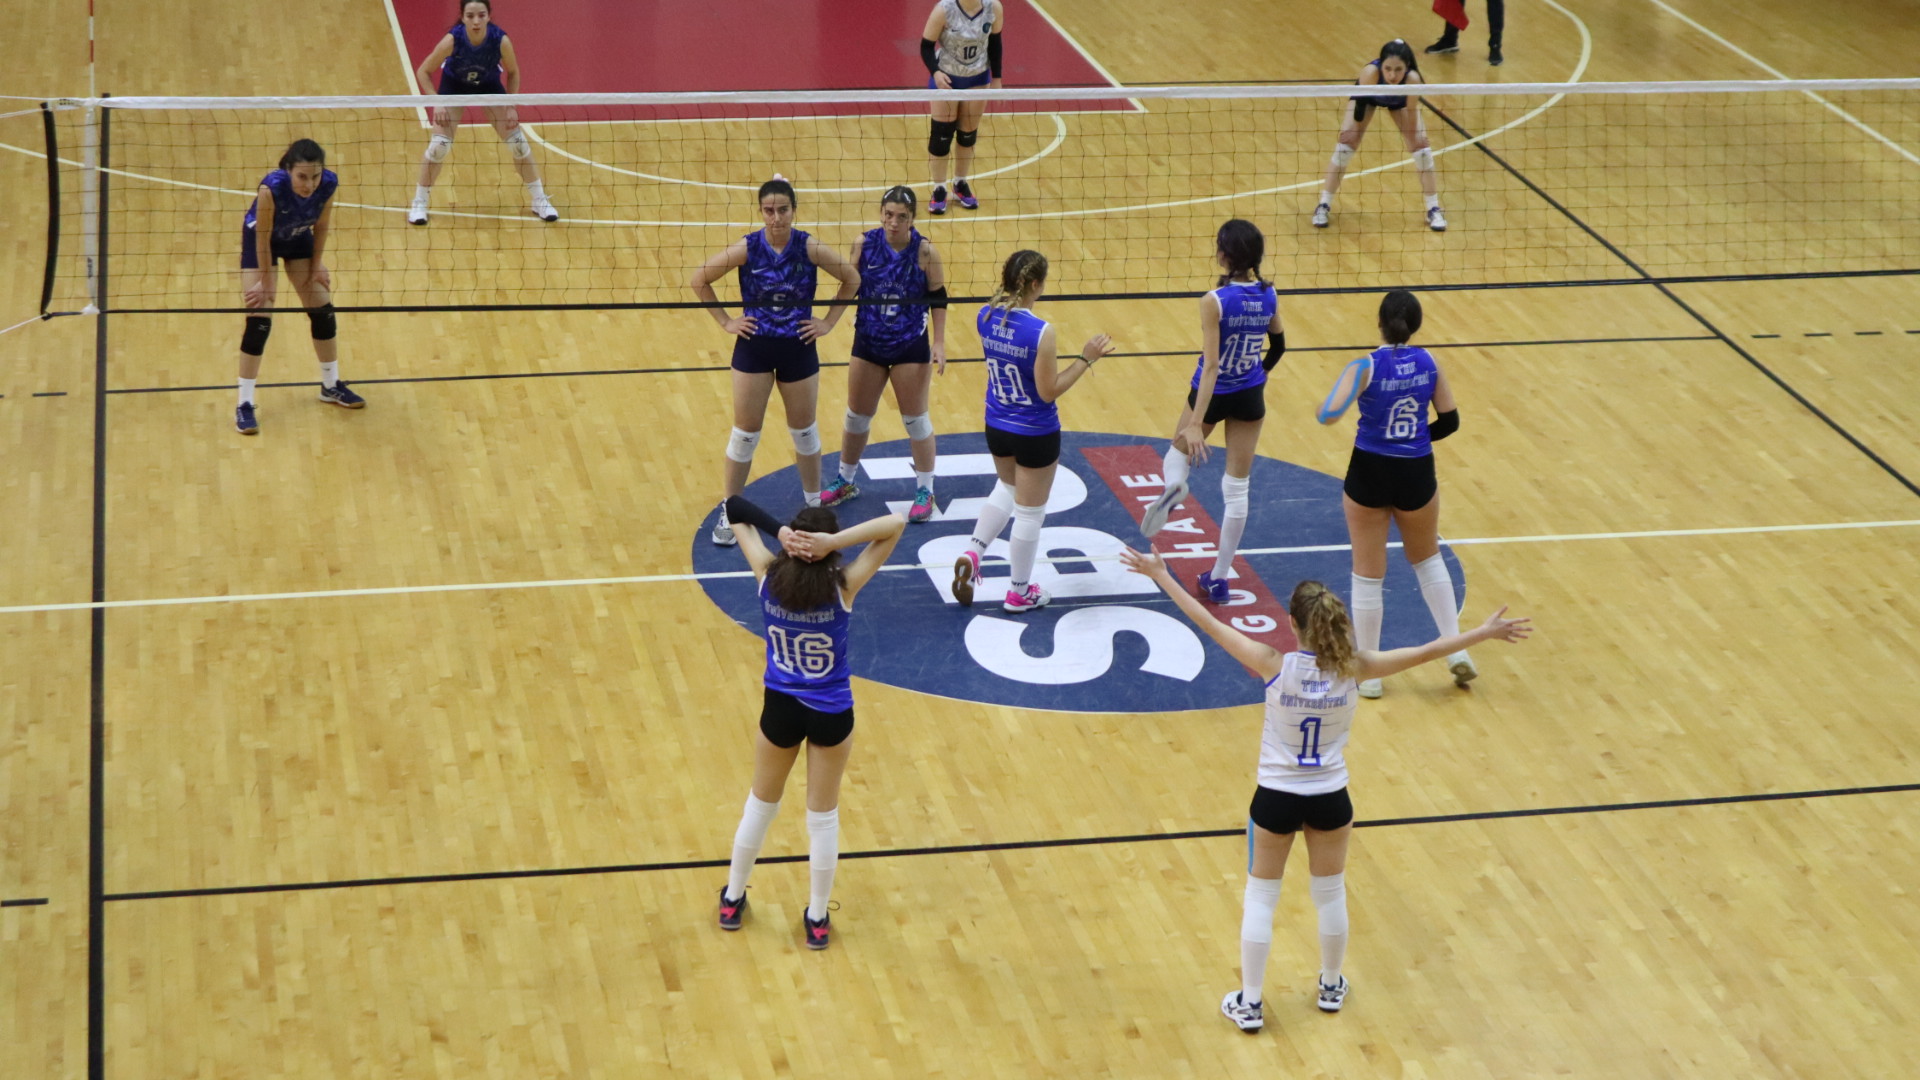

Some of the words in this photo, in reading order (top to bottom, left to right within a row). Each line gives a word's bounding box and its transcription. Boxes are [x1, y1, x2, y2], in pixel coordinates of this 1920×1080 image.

[963, 46, 977, 60] 10
[992, 323, 1015, 340] THK
[1218, 333, 1265, 375] 15
[986, 357, 1033, 405] 11
[1385, 396, 1419, 439] 6
[767, 624, 835, 679] 16
[1280, 691, 1347, 710] ÜNİVERSİTESİ
[1301, 679, 1330, 693] THK
[1297, 716, 1322, 767] 1
